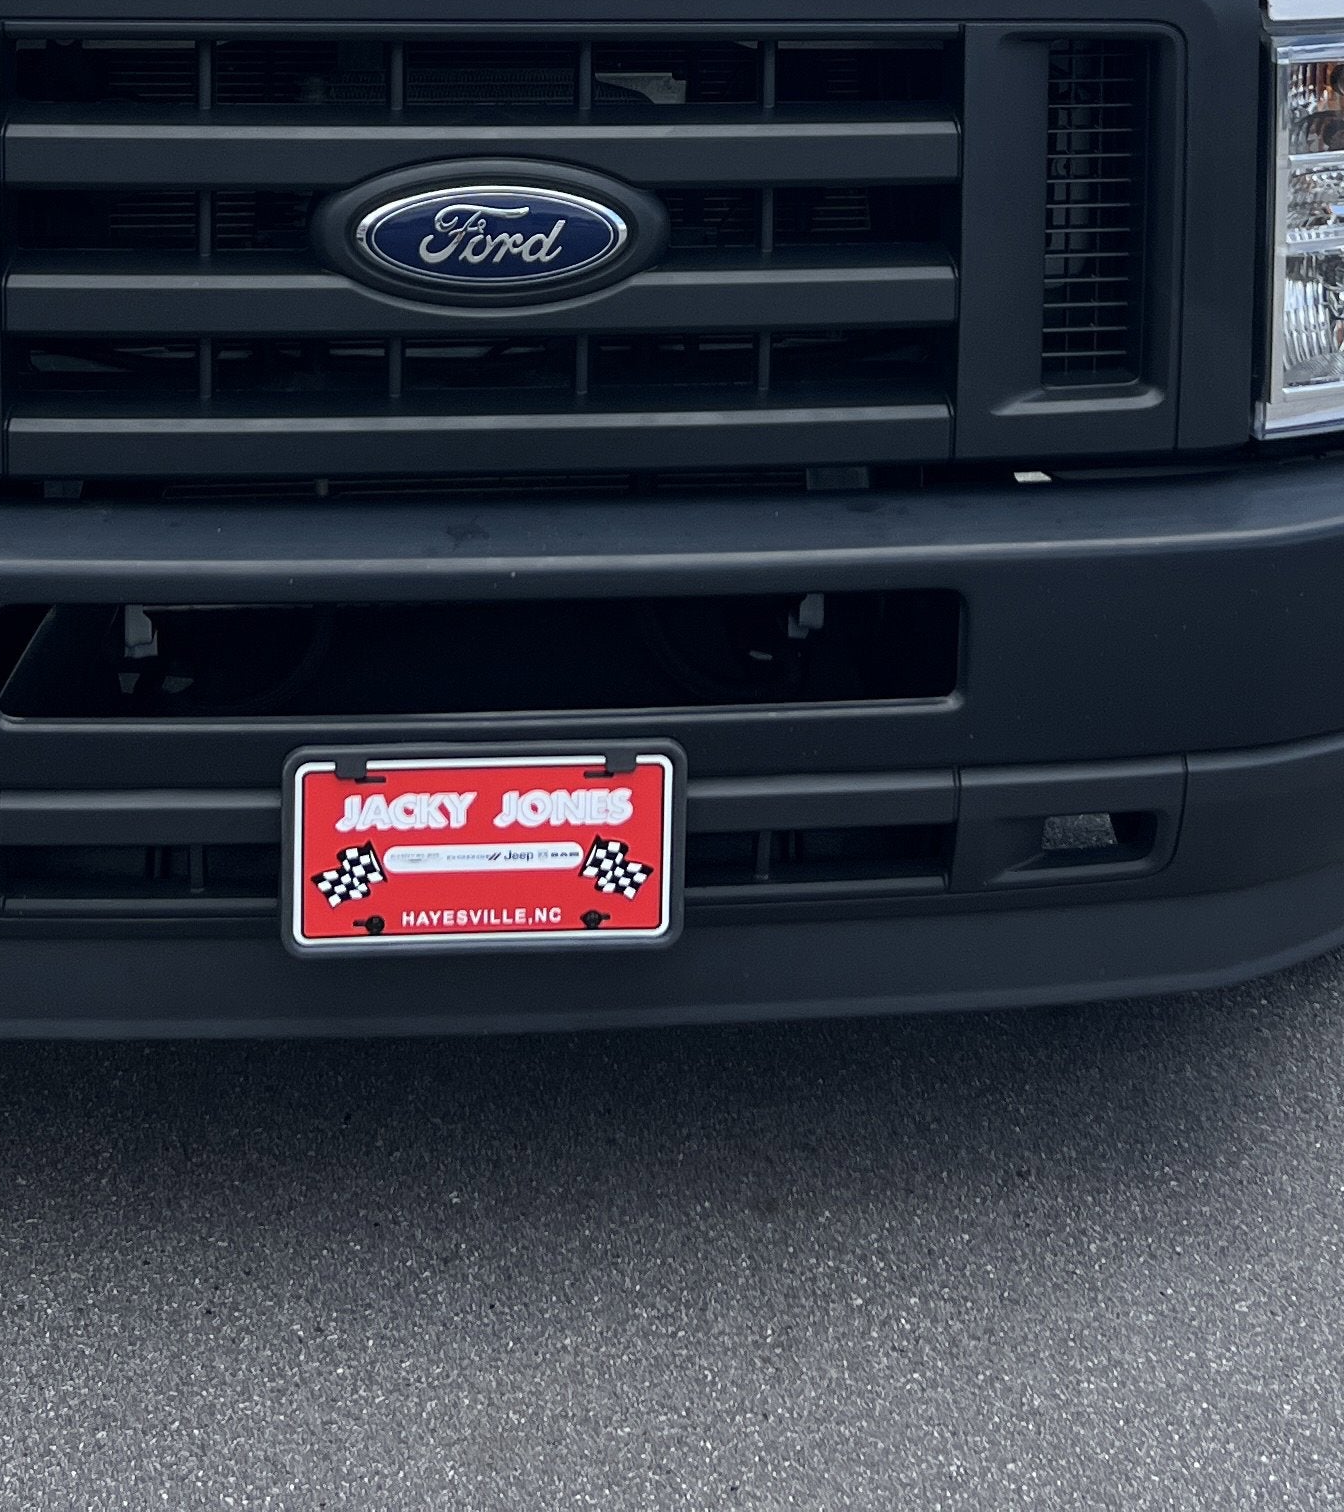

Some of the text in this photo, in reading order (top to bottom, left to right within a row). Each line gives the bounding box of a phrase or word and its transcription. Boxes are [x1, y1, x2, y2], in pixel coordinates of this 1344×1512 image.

[418, 203, 566, 265] Ford
[335, 788, 634, 832] JACKY JONES
[504, 849, 534, 862] Jeep
